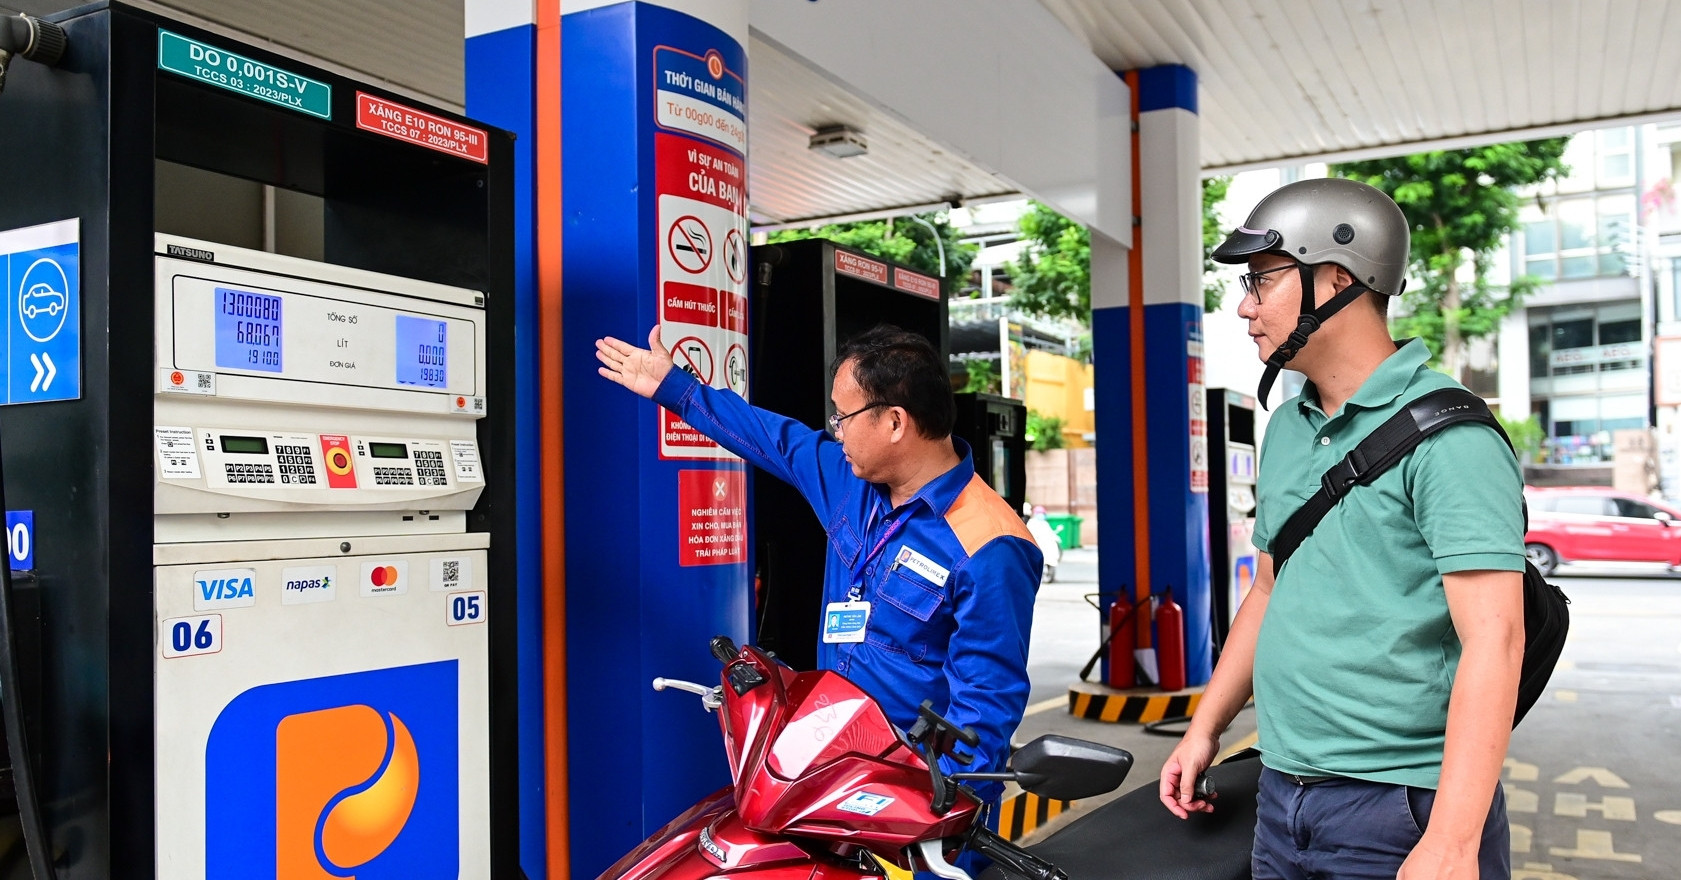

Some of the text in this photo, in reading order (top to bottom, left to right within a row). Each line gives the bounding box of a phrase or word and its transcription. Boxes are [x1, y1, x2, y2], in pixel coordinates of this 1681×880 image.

[189, 43, 308, 94] DO 0,001S-V
[194, 65, 227, 84] TCCS
[230, 77, 244, 89] 03
[253, 84, 303, 107] 2023/PLX
[664, 70, 692, 90] THỜI
[694, 80, 716, 99] GIAN
[717, 87, 732, 106] BÁN
[368, 102, 478, 145] XĂNG E10 RON 95-III
[666, 101, 683, 117] Từ
[685, 106, 714, 126] 00g00
[715, 117, 730, 134] đến
[381, 120, 408, 136] TCCS
[409, 129, 420, 139] 07
[427, 134, 468, 153] 2023/PLX
[687, 148, 739, 179] VÌ SỰ AN TOÀN
[688, 168, 739, 207] CỦA BẠN
[169, 245, 213, 260] TATSUNO
[222, 291, 279, 321] 1300080
[667, 296, 716, 313] CẤM HÚT THUỐC
[327, 311, 358, 325] TỔNG SỐ
[337, 338, 349, 348] LÍT
[438, 323, 444, 343] 0
[329, 360, 356, 369] ĐƠN GIÁ
[420, 368, 444, 382] 19830
[665, 431, 681, 442] ĐIỆN
[691, 506, 718, 517] NGHIÊM
[719, 507, 731, 516] CẤM
[691, 522, 703, 530] XIN
[695, 547, 711, 558] TRÁI
[196, 577, 254, 601] VISA
[286, 577, 321, 593] napas
[453, 595, 480, 621] 05
[172, 619, 213, 652] 06
